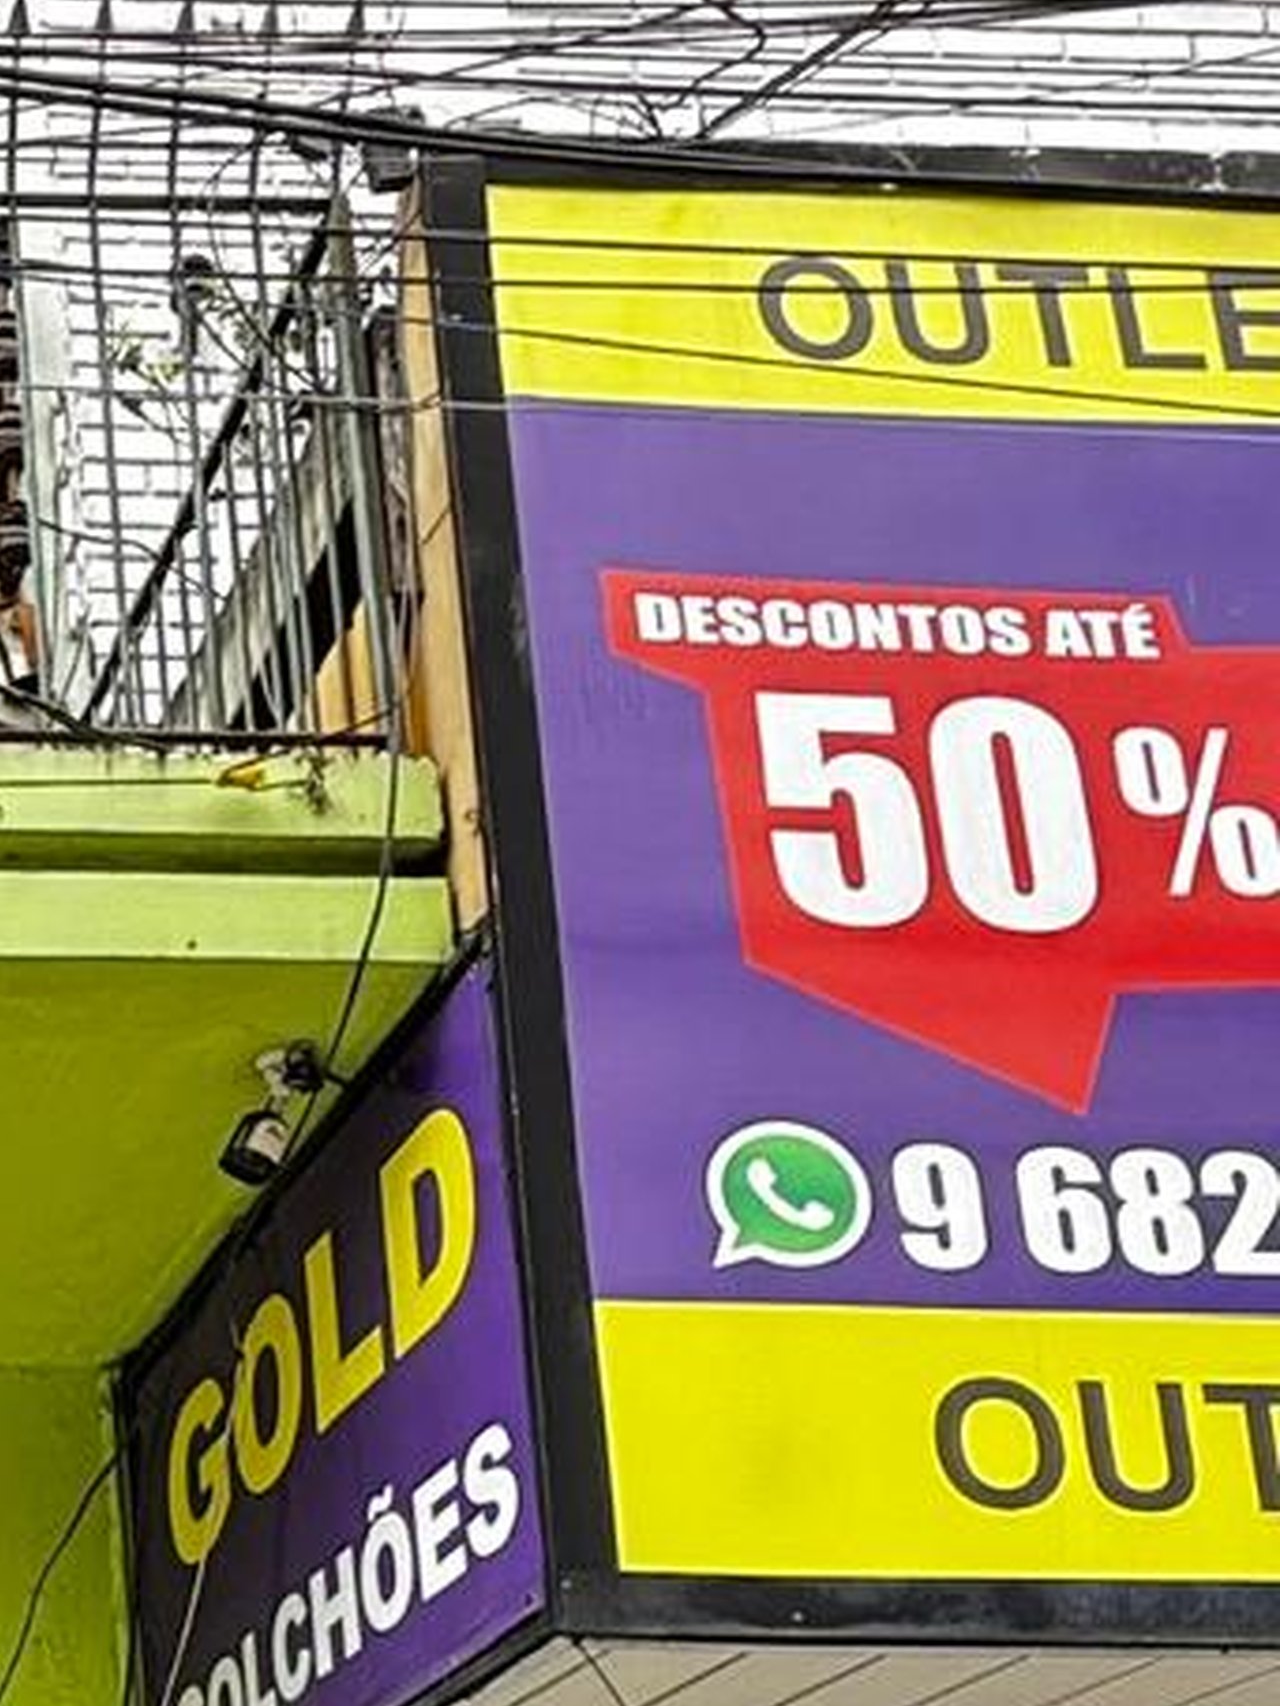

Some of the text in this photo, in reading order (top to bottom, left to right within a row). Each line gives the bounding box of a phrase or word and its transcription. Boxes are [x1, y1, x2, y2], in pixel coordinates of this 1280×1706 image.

[634, 592, 1162, 659] DESCONTOS ATÉ
[892, 1143, 989, 1270] 9
[167, 1108, 476, 1566] GOLD
